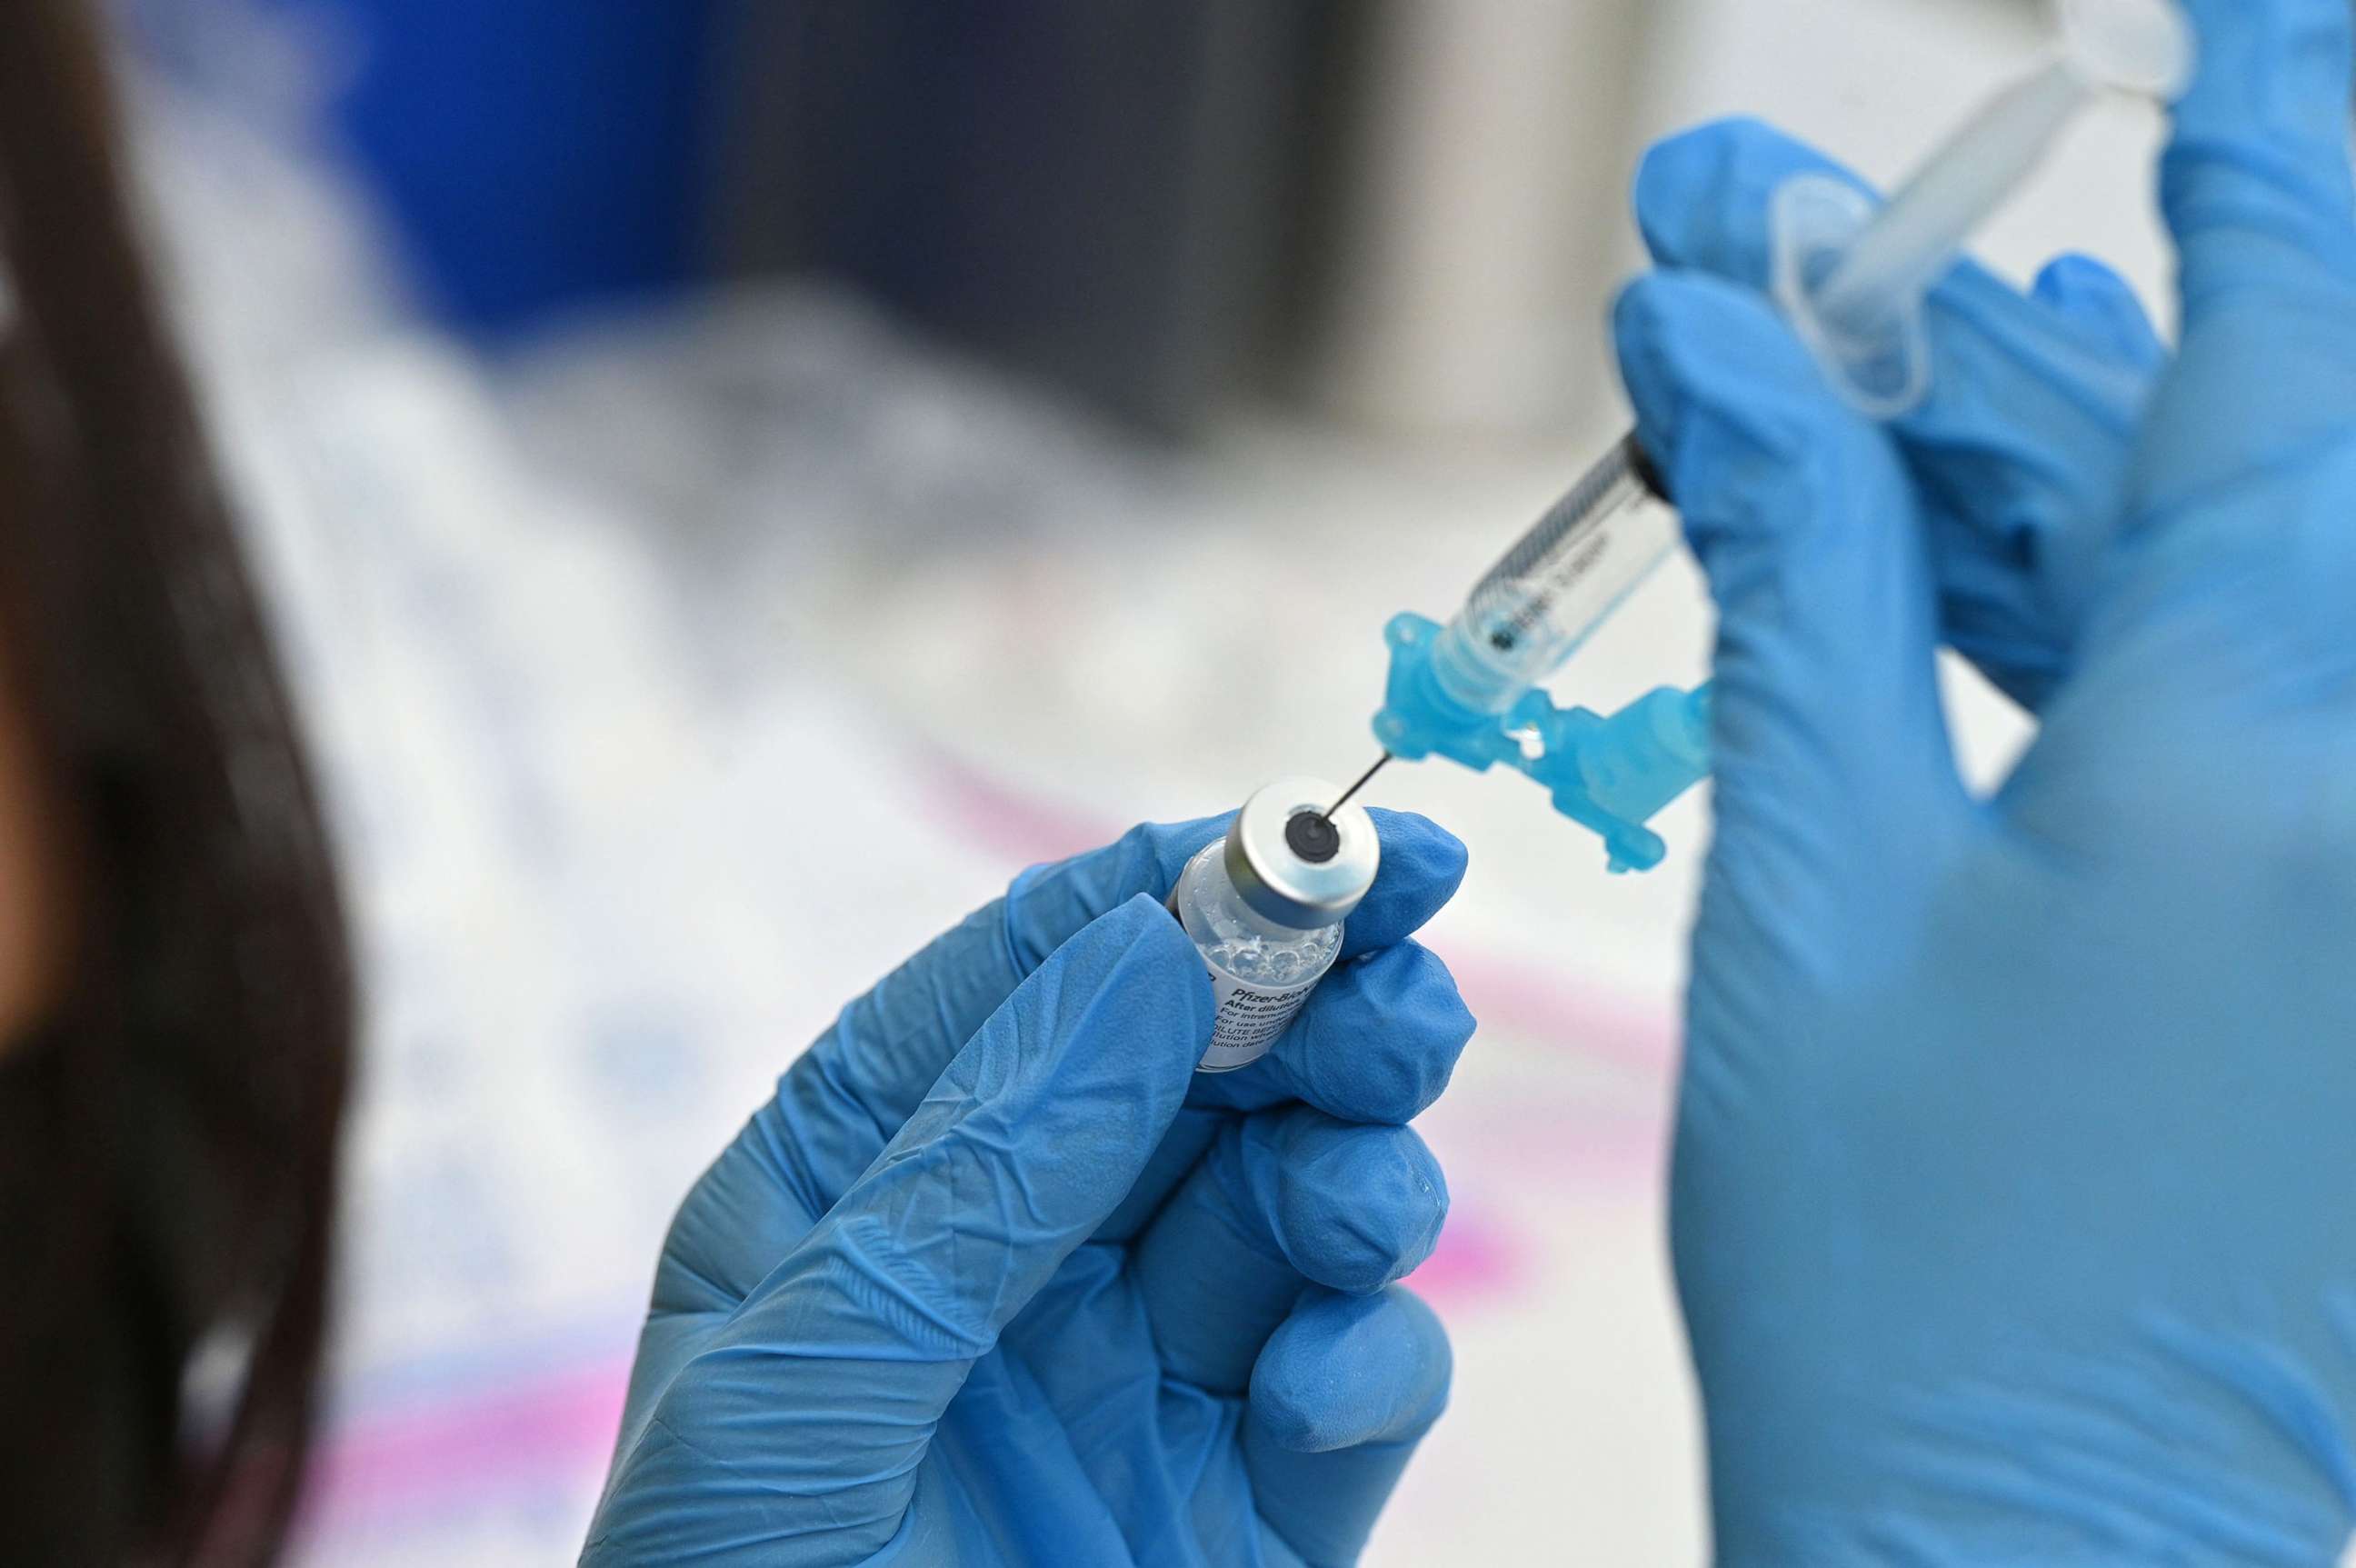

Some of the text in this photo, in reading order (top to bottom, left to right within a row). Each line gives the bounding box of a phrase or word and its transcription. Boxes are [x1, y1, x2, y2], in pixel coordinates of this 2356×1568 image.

[1224, 1000, 1256, 1011] After
[1221, 1007, 1240, 1016] For
[1215, 1015, 1233, 1024] For
[1210, 1039, 1240, 1047] lution
